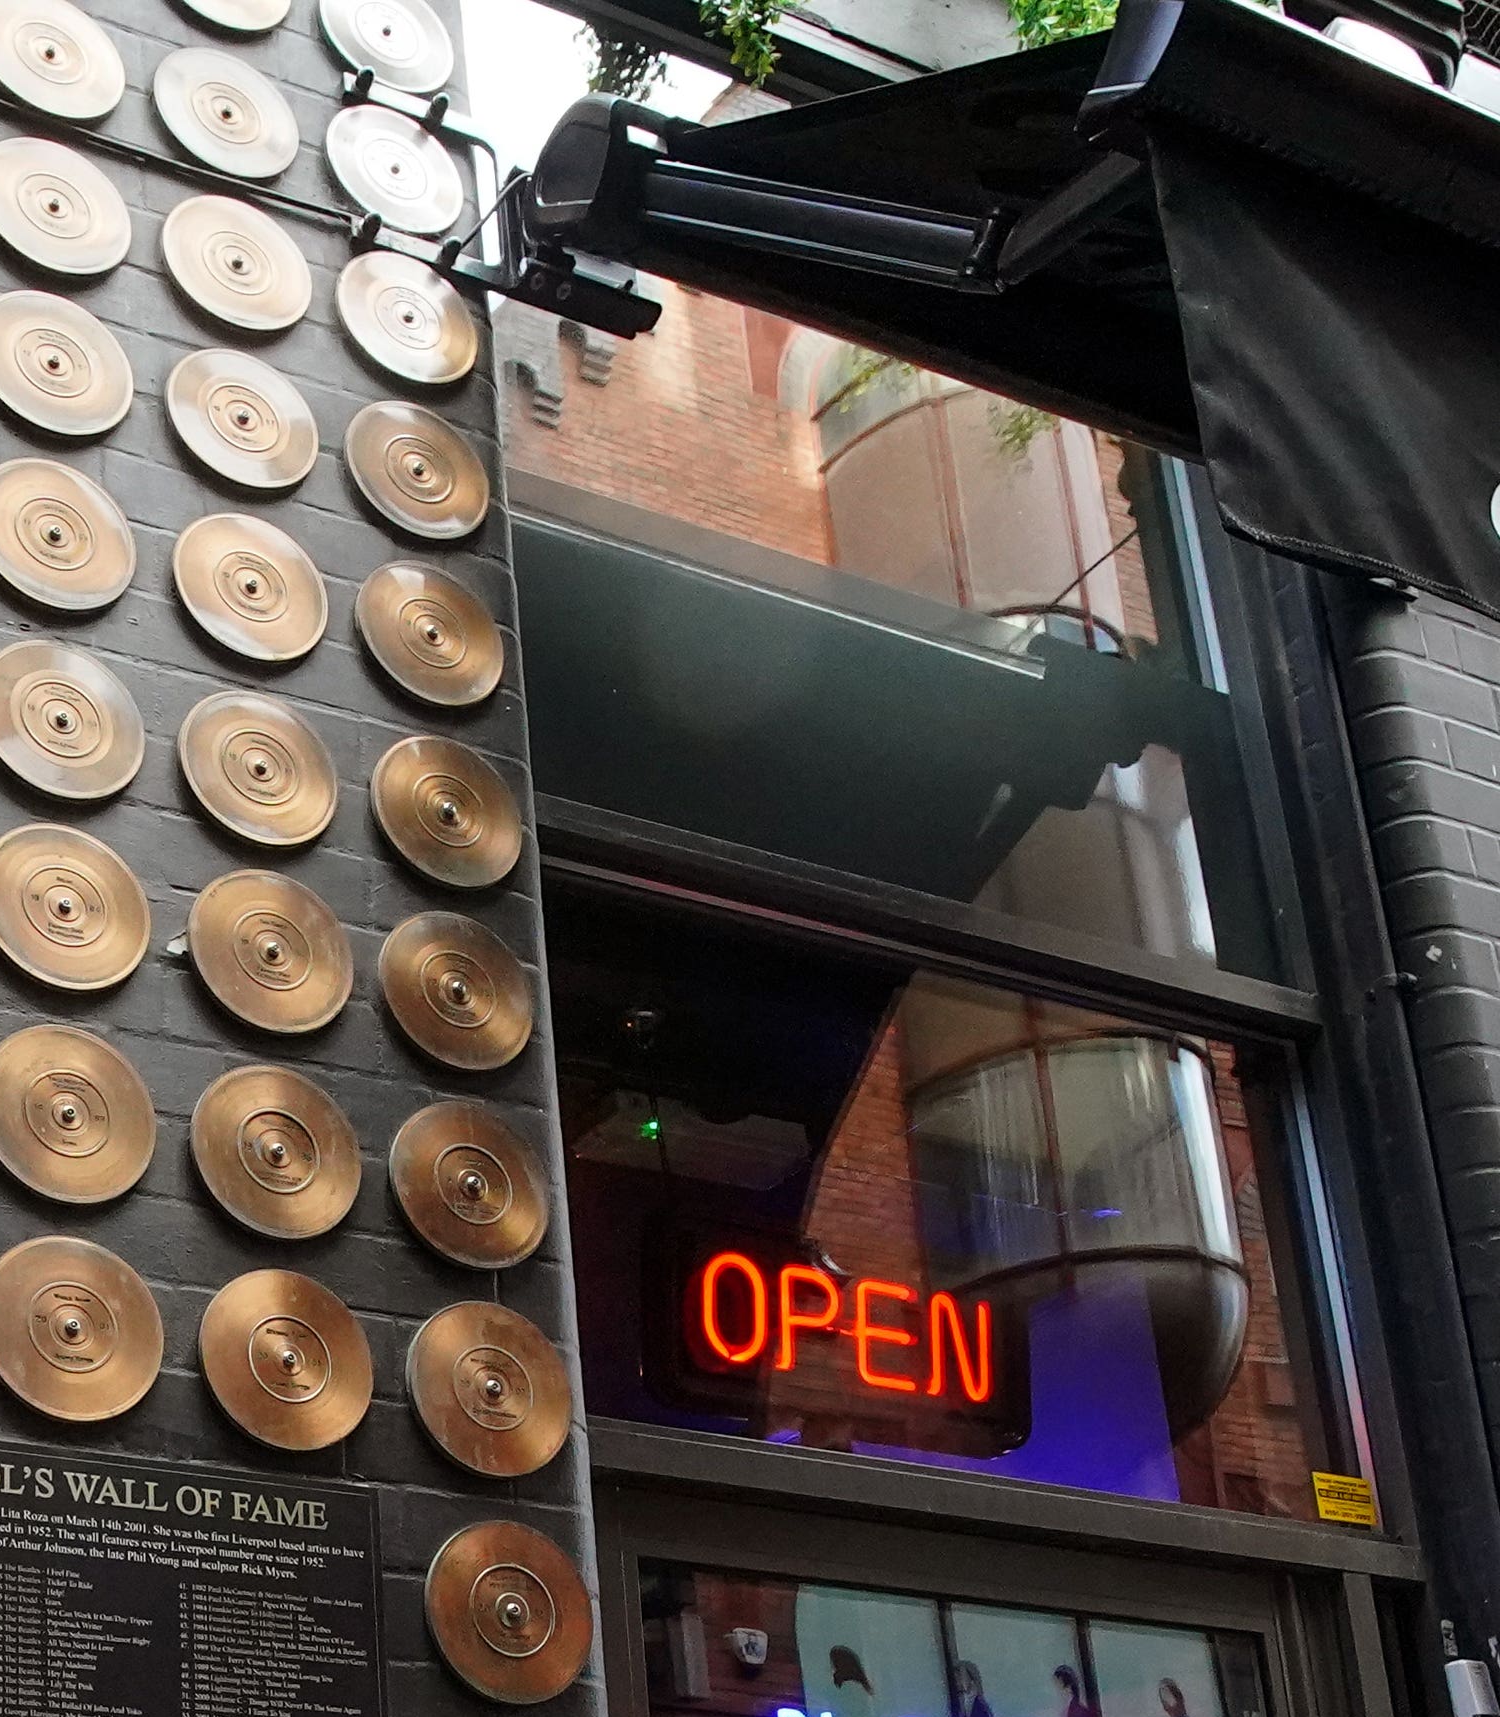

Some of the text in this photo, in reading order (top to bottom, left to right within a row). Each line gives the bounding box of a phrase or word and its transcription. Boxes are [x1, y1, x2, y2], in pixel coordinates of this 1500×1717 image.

[701, 1252, 991, 1402] OPEN
[65, 1471, 168, 1512] WALL
[176, 1484, 221, 1518] OF
[232, 1491, 327, 1530] FAME
[1, 1507, 20, 1520] Lita
[23, 1510, 48, 1523] Roza
[50, 1517, 63, 1525] on
[66, 1515, 97, 1529] March
[101, 1519, 121, 1532] 14th
[124, 1521, 150, 1535] 2001.
[153, 1525, 170, 1537] She
[173, 1531, 192, 1540] was
[194, 1529, 208, 1541] the
[211, 1531, 228, 1544] first
[232, 1534, 276, 1552] Liverpool
[279, 1539, 304, 1552] based
[307, 1542, 329, 1555] artist
[332, 1546, 340, 1556] to
[343, 1546, 364, 1559] have
[8, 1537, 41, 1550] Arthur
[44, 1540, 86, 1558] Johnson,
[89, 1545, 104, 1557] the
[107, 1547, 124, 1559] late
[127, 1549, 146, 1561] Phil
[148, 1551, 179, 1567] Young
[182, 1555, 198, 1567] and
[202, 1557, 238, 1574] sculptor
[241, 1561, 262, 1574] Rick
[266, 1564, 296, 1580] Myers.
[14, 1523, 23, 1534] in
[28, 1524, 53, 1537] 1952.
[57, 1527, 75, 1540] The
[78, 1530, 98, 1542] wall
[102, 1532, 139, 1547] features
[141, 1541, 167, 1552] every
[171, 1540, 216, 1558] Liverpool
[219, 1545, 254, 1559] number
[256, 1553, 273, 1561] one
[275, 1551, 298, 1564] since
[302, 1554, 326, 1567] 1952.
